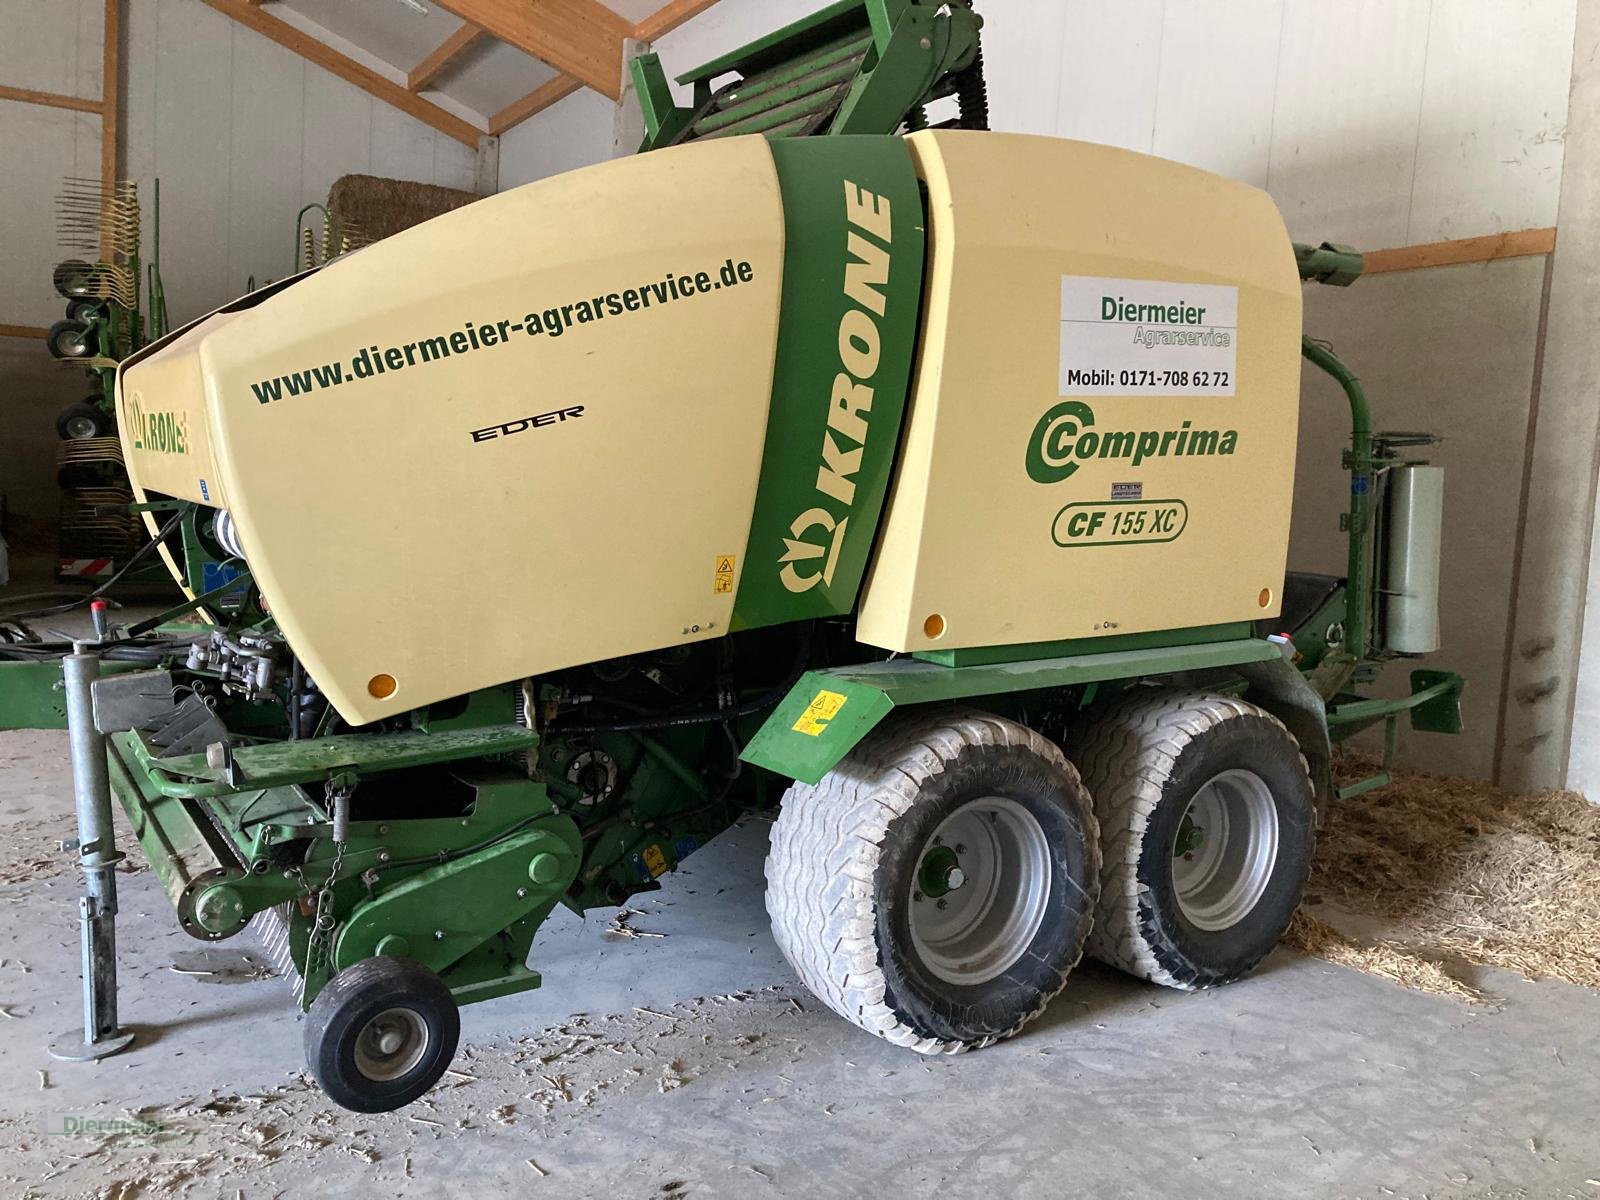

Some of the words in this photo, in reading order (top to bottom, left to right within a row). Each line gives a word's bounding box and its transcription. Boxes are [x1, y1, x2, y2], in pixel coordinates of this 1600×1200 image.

[1101, 296, 1206, 324] Diermeier
[250, 258, 754, 405] www.diermeier-agrarservice.de
[816, 180, 892, 506] KRONE
[1133, 325, 1231, 349] Agrarservice
[1067, 369, 1115, 387] Mobil:
[1119, 370, 1189, 387] 0171-708
[1192, 371, 1209, 387] 62
[1213, 371, 1229, 387] 72
[469, 405, 585, 443] EDER
[1067, 511, 1107, 538] CF
[1111, 511, 1147, 536] 155
[1148, 508, 1178, 534] XC
